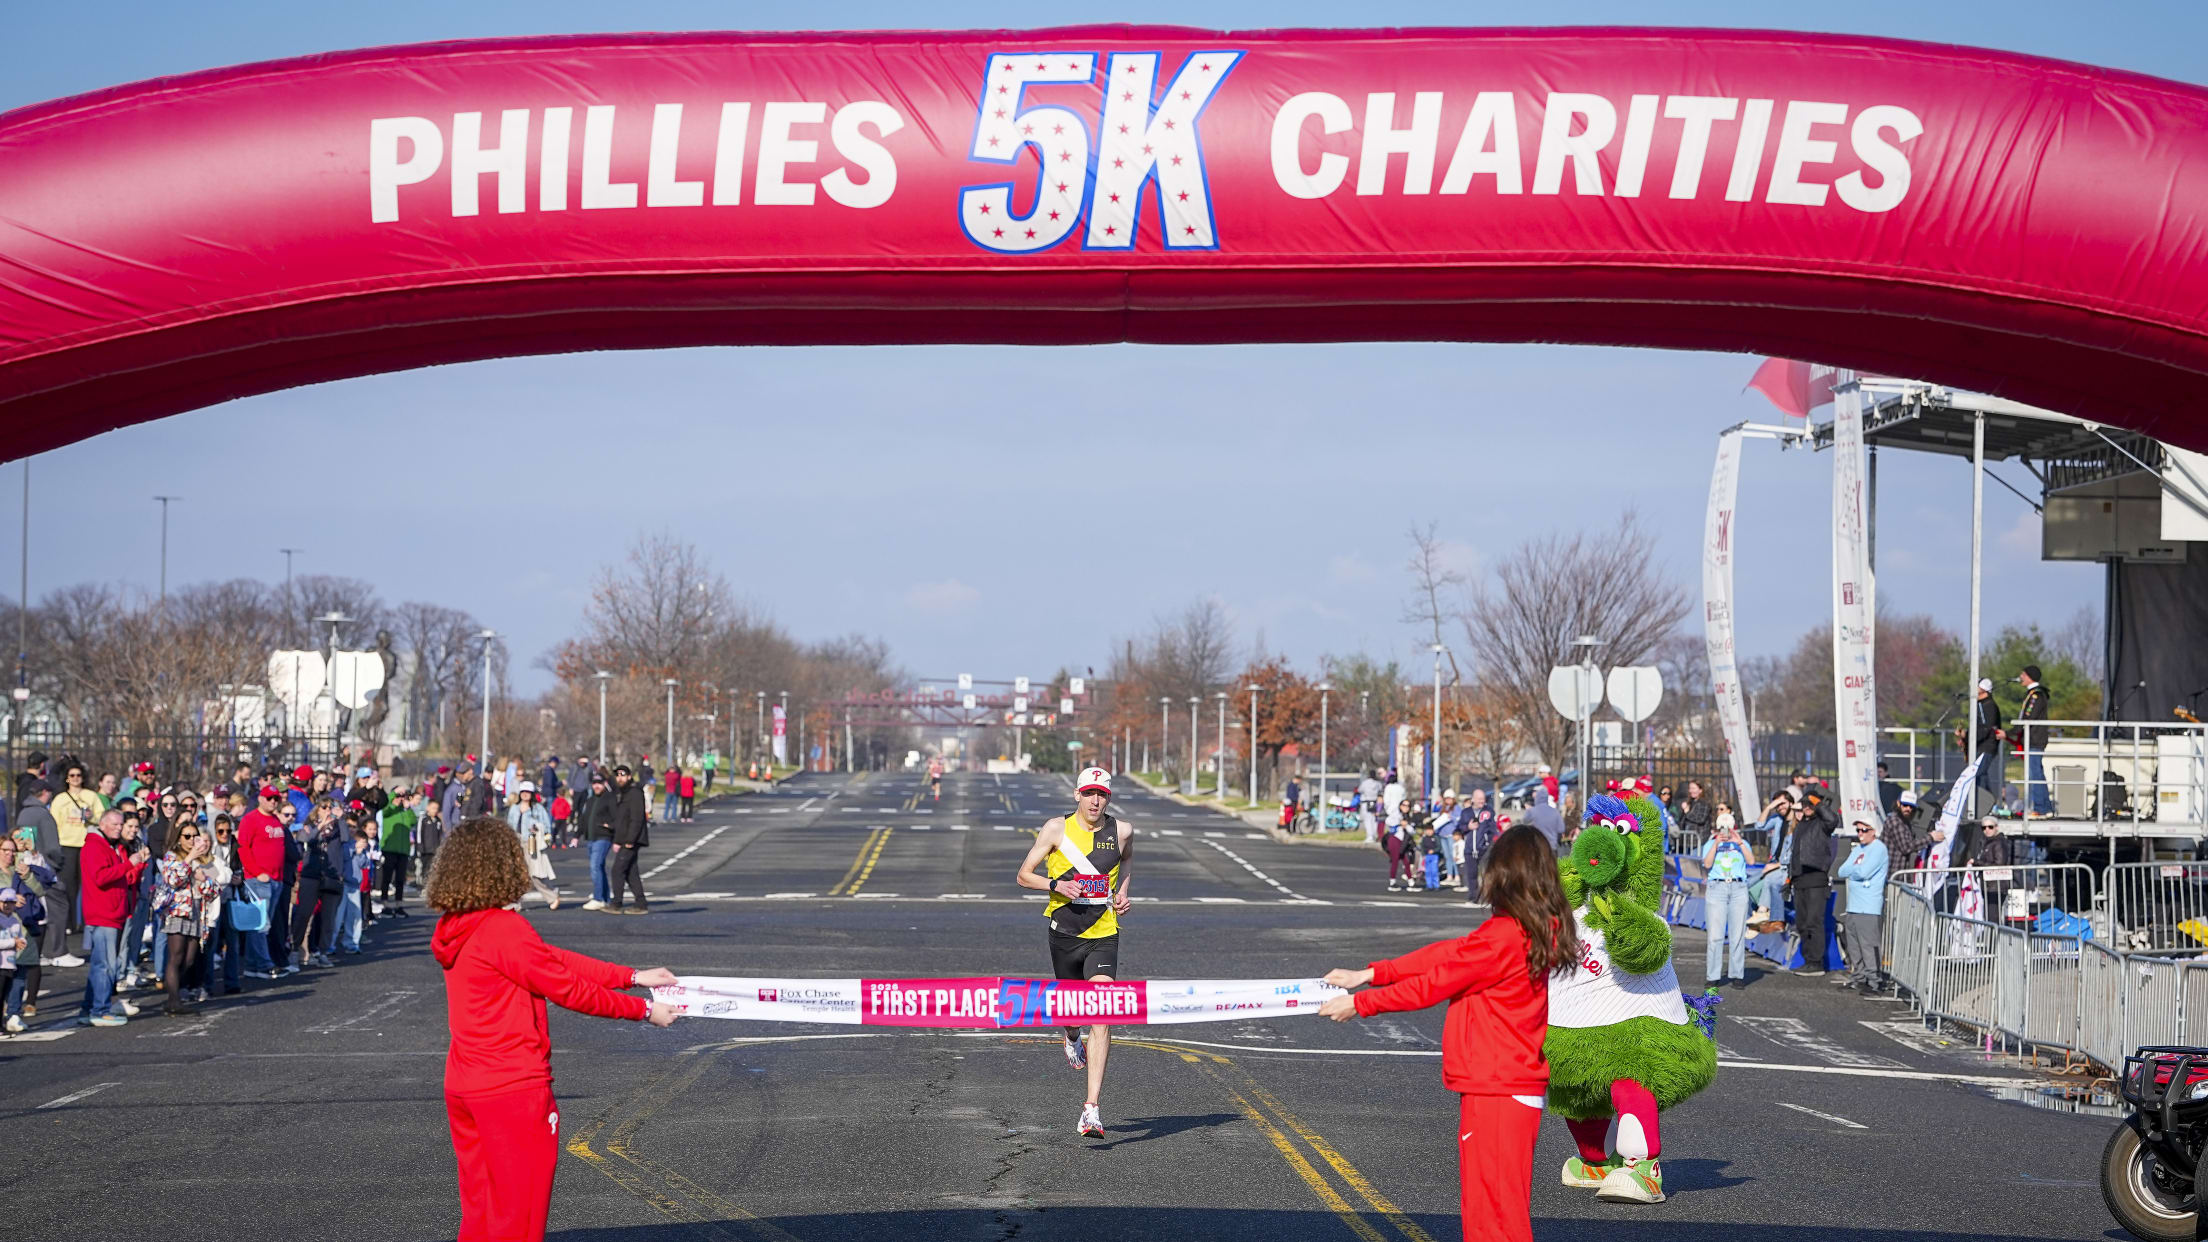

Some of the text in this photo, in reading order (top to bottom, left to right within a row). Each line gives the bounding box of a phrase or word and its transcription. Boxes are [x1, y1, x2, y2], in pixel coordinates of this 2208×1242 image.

[370, 50, 1924, 254] PHILLIES 5K CHARITIES
[1092, 770, 1102, 782] P
[1096, 842, 1115, 850] GSTC
[870, 983, 899, 991] 2026
[780, 989, 841, 999] Fox Chase
[871, 979, 1139, 1026] FIRST PLACE 5K FINISHER
[1216, 1002, 1263, 1011] RE/MAX
